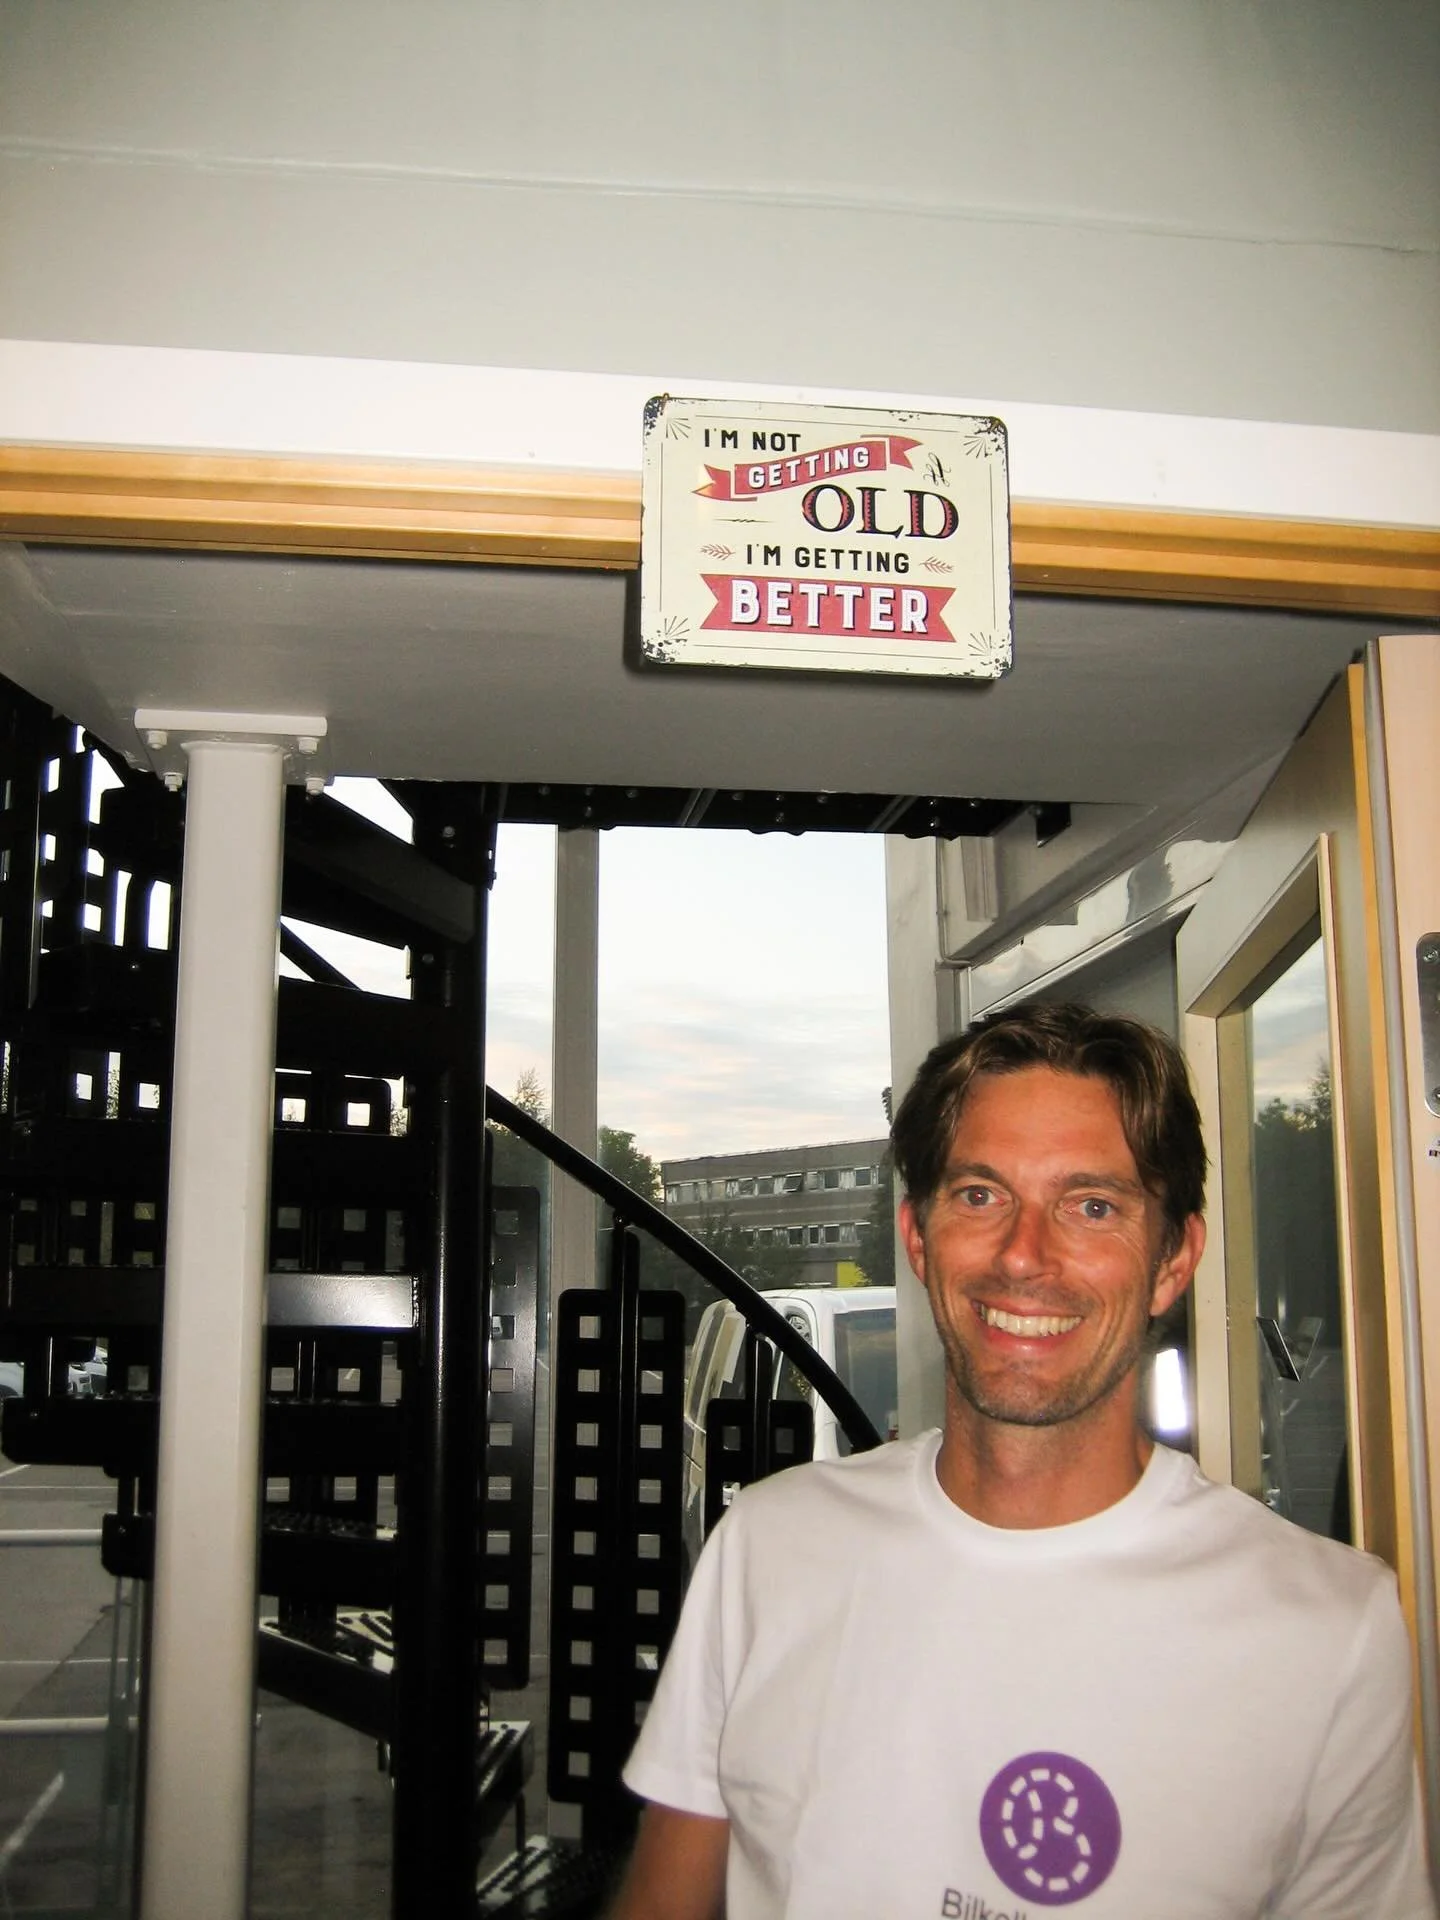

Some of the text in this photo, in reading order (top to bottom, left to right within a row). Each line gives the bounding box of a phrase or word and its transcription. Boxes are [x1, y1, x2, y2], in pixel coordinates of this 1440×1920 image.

[704, 428, 801, 452] I'M NOT
[749, 447, 869, 489] GETTING
[802, 484, 959, 539] OLD
[746, 544, 909, 573] I'M GETTING
[731, 579, 928, 633] BETTER
[942, 1887, 1027, 1920] Bilk
